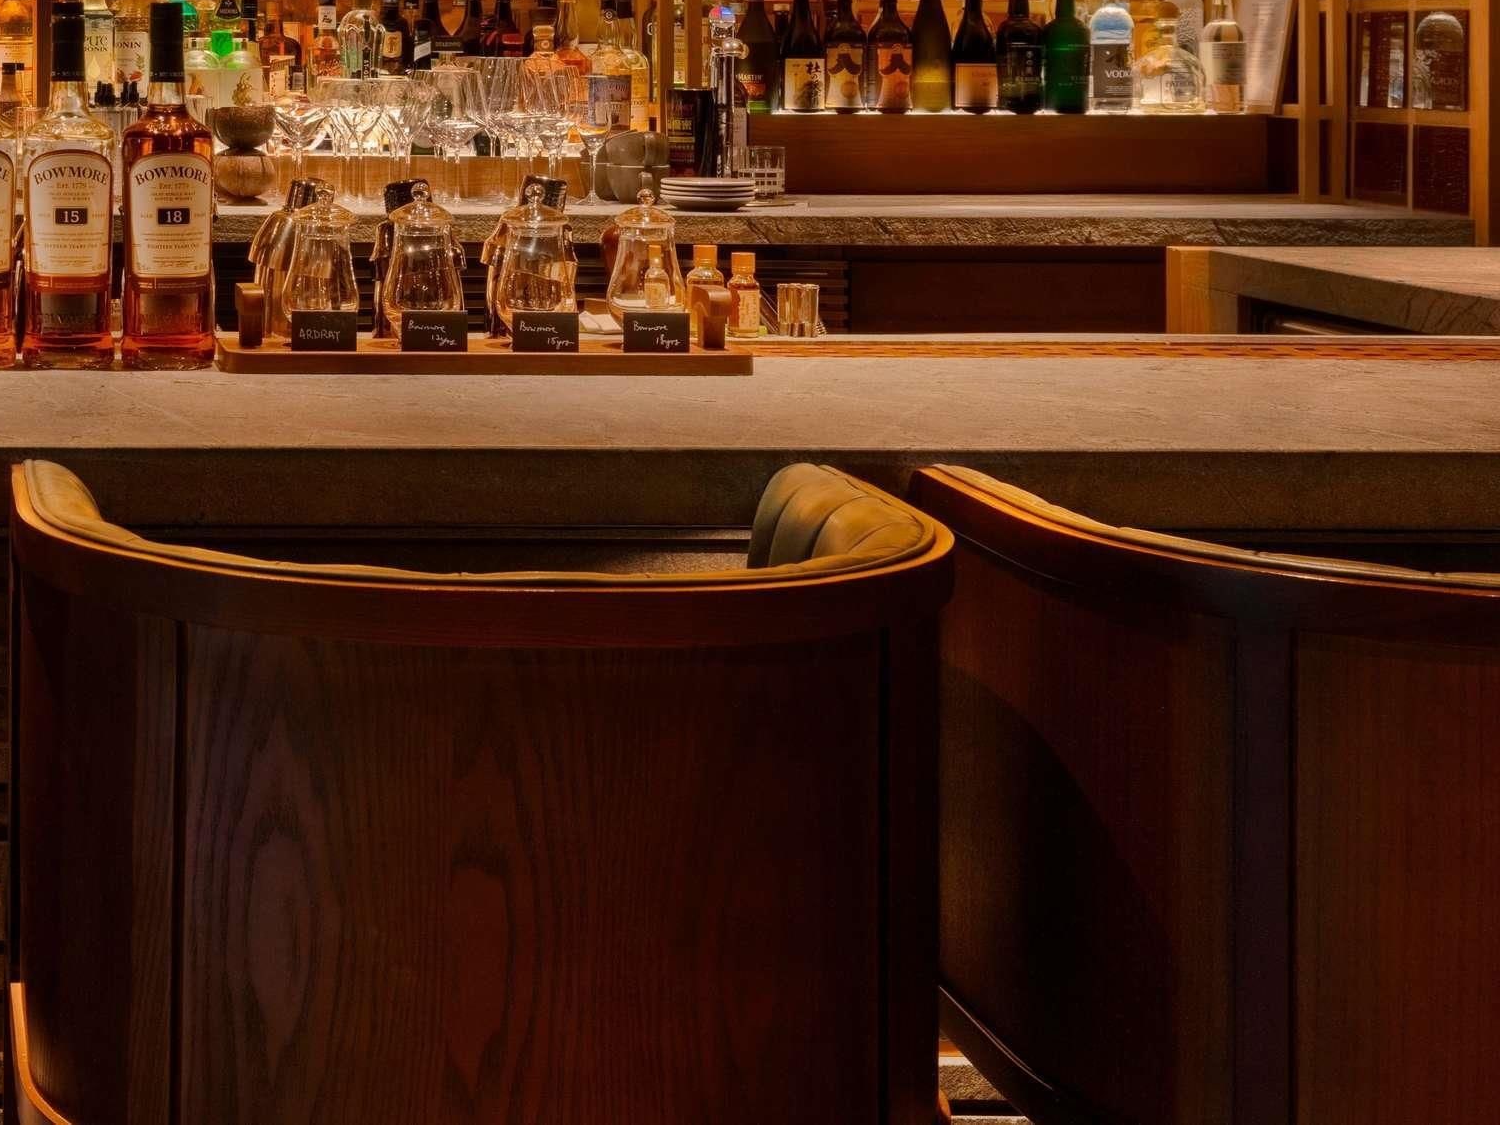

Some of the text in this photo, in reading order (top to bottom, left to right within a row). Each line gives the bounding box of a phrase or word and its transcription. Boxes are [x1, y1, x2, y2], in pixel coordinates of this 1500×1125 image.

[116, 41, 141, 49] ONIN
[34, 166, 108, 185] BOWMORE
[135, 166, 208, 186] BOWMORE
[63, 210, 79, 223] 15
[166, 210, 182, 223] 18
[299, 329, 341, 342] ARDRAY
